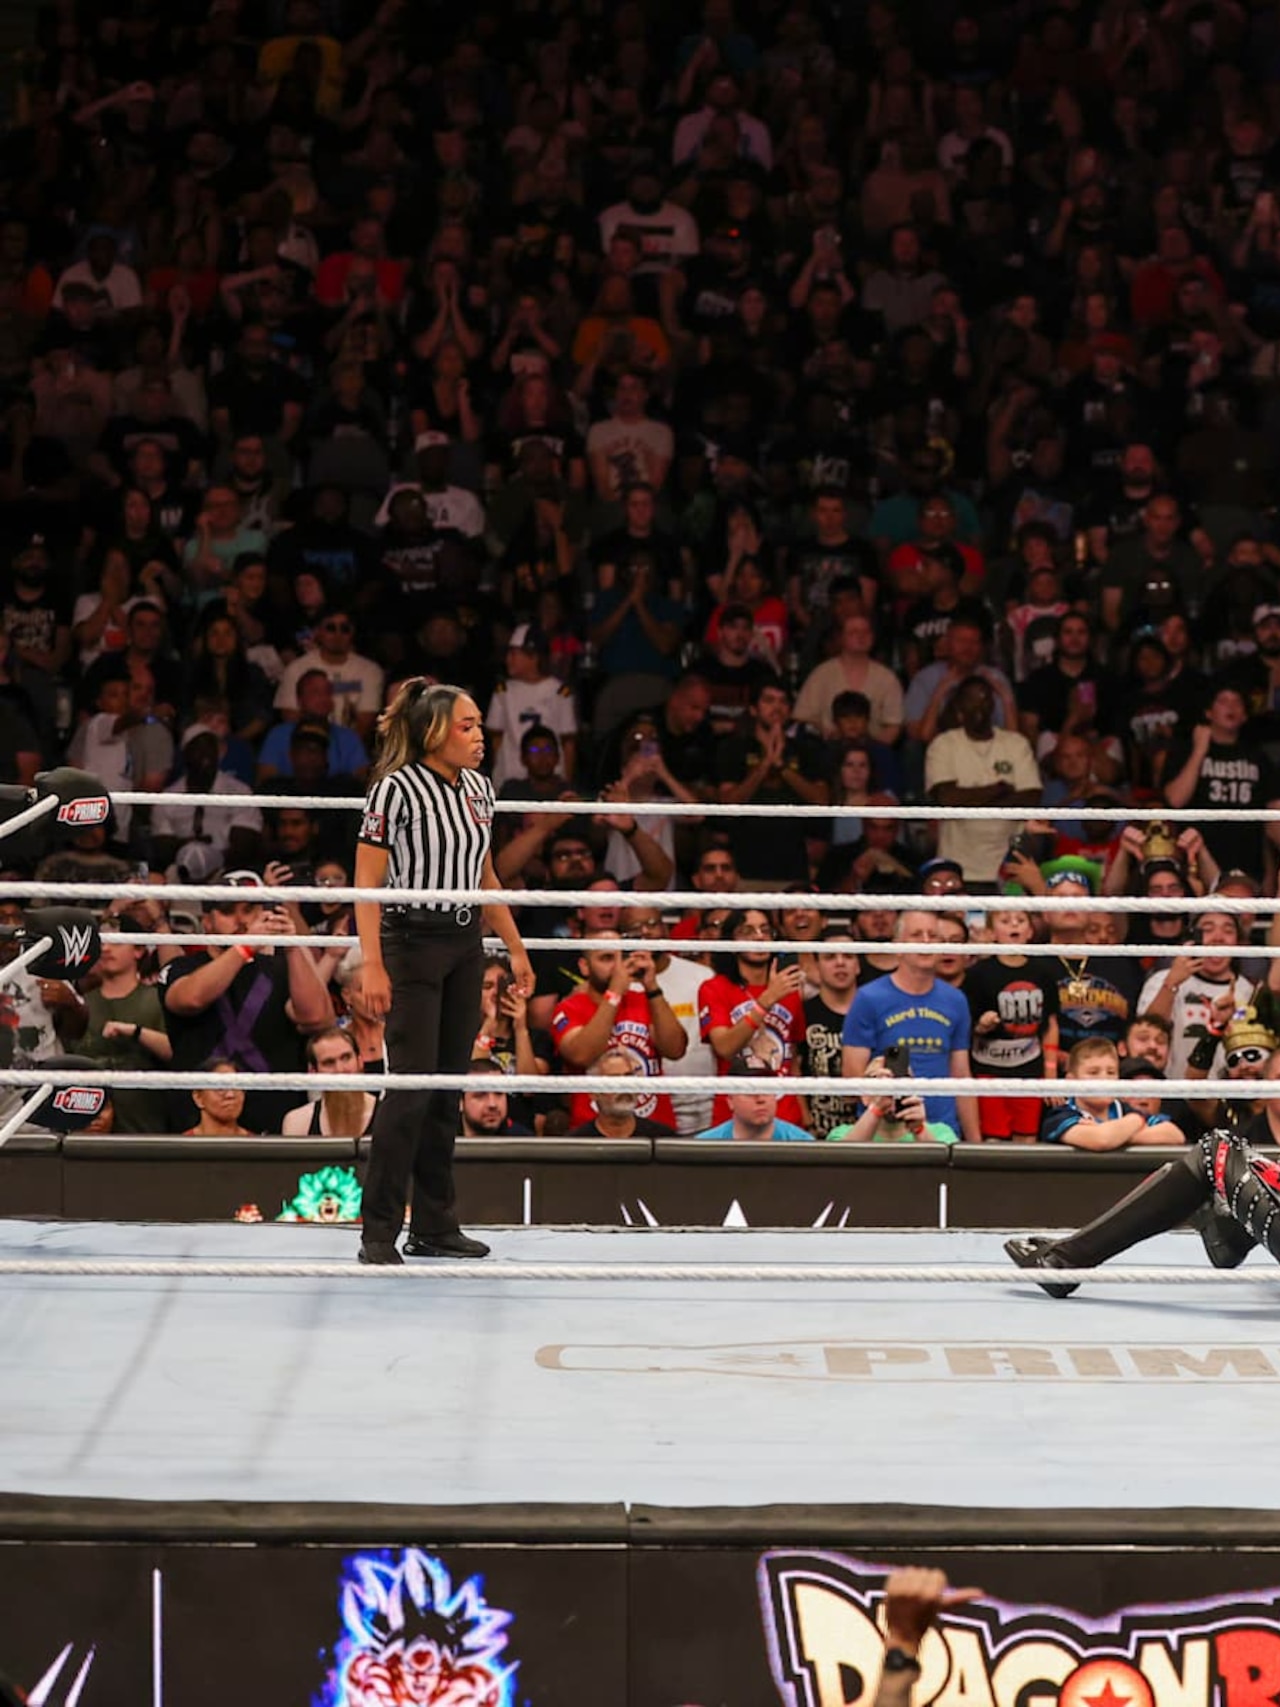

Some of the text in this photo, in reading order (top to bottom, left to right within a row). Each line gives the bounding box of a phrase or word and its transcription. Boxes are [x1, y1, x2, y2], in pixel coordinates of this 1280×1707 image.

[1209, 780, 1252, 804] 3:16
[73, 801, 106, 821] PRIME
[68, 1090, 100, 1109] PRIME
